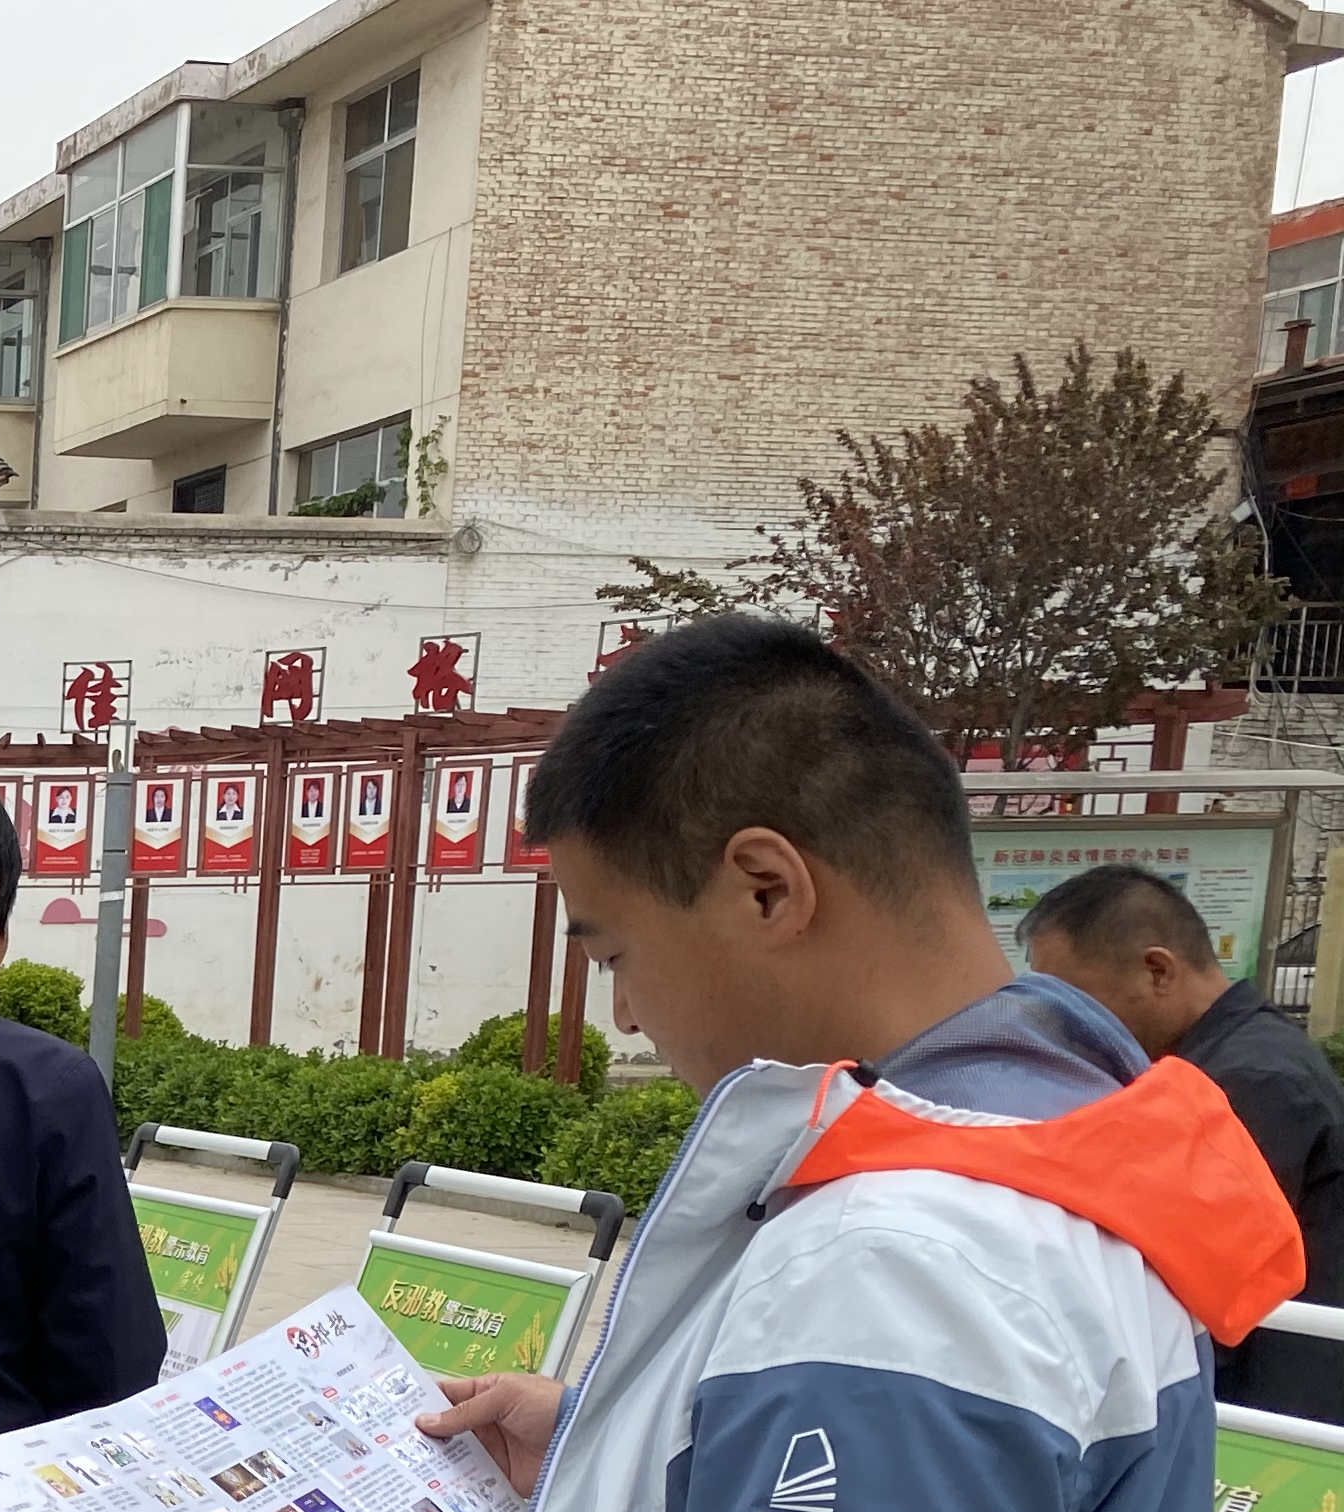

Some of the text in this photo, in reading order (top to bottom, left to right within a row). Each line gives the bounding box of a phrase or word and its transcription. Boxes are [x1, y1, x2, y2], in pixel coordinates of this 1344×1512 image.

[137, 1224, 211, 1266] 邪教警示教育
[178, 1268, 205, 1295] 宣传
[380, 1279, 508, 1338] 反邪教警示教育
[461, 1342, 498, 1373] 宣传
